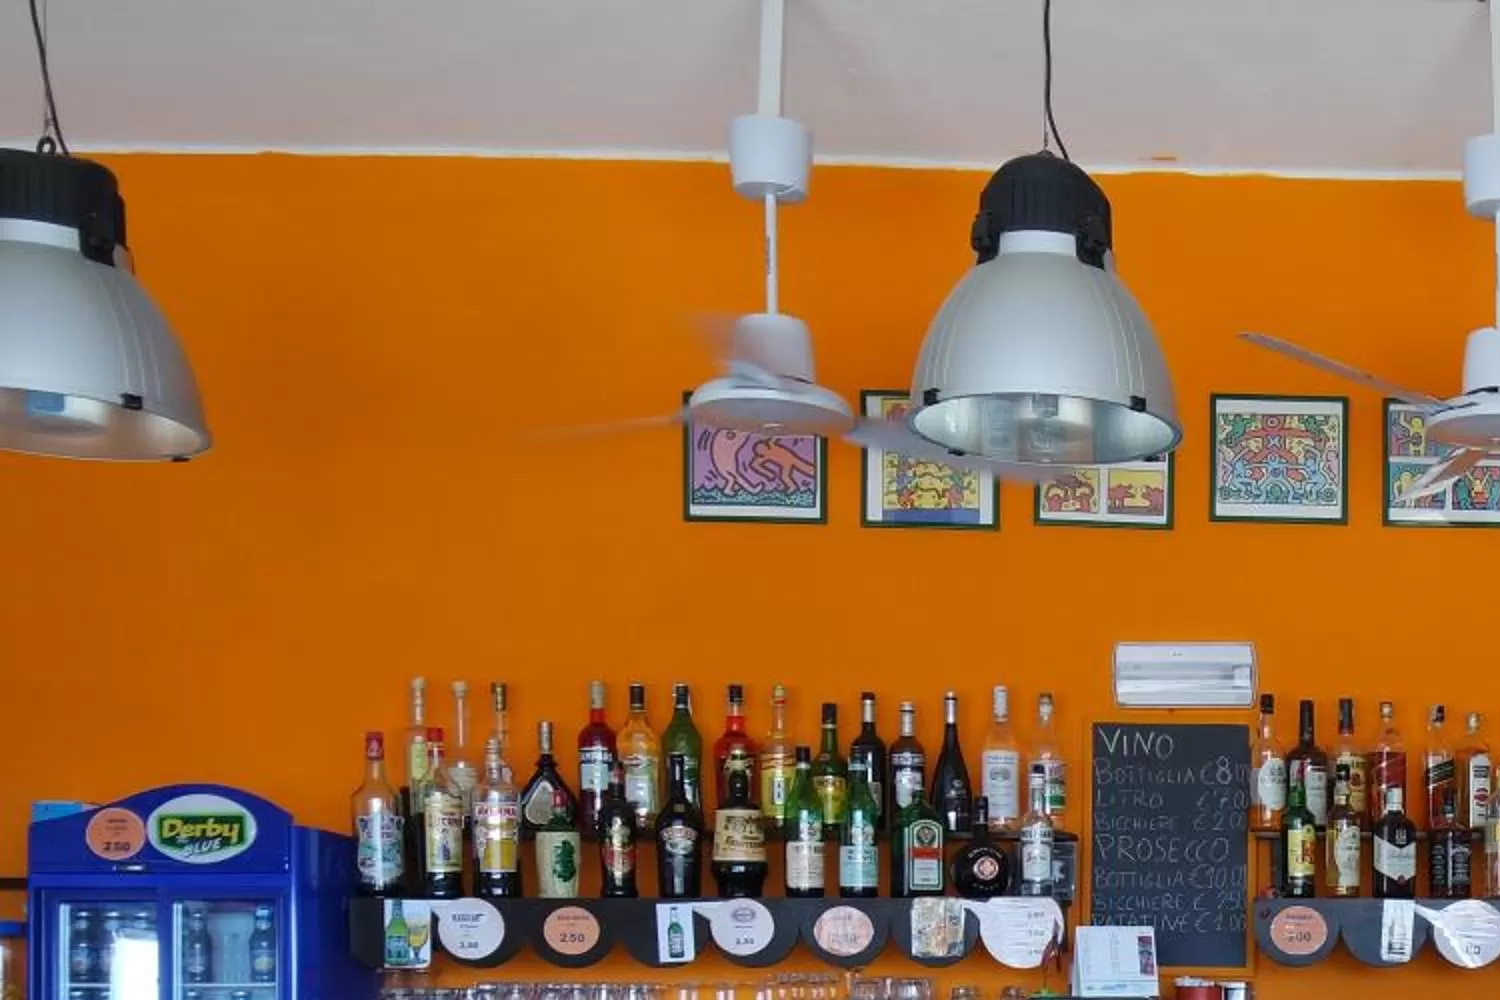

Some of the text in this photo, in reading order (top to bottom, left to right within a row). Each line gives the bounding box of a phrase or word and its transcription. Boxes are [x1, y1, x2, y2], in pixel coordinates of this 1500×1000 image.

[1097, 727, 1175, 760] VINO
[163, 817, 241, 843] Derby
[1094, 832, 1230, 863] PROSECCO
[1094, 866, 1186, 891] BOTTIGLIA
